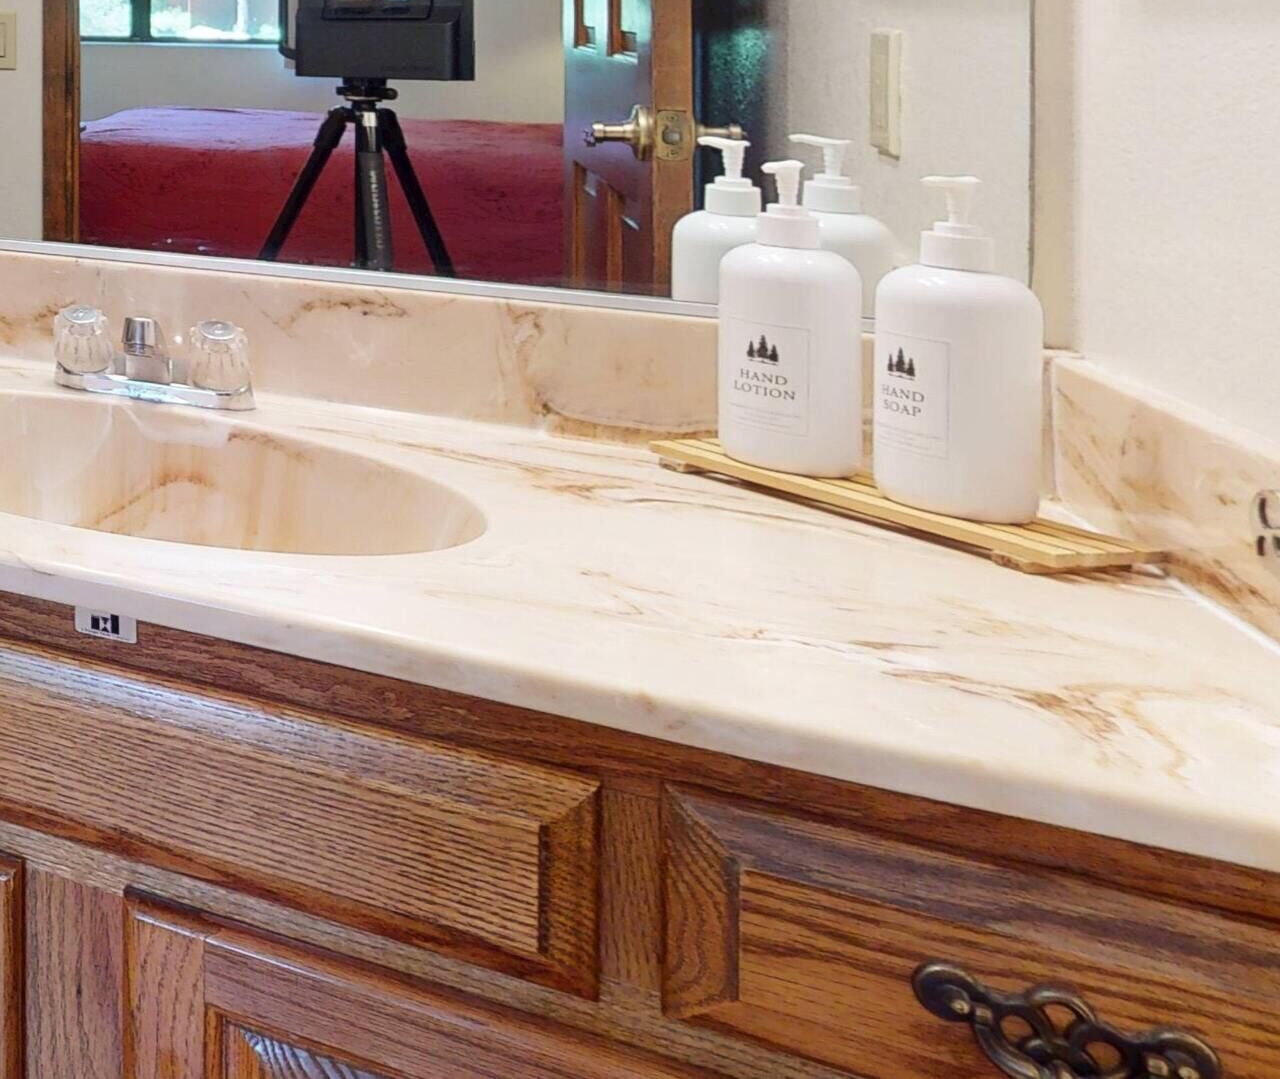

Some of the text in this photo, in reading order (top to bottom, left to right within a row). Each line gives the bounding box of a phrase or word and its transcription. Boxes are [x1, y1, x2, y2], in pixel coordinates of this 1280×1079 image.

[740, 367, 788, 386] HAND
[733, 379, 796, 401] LOTION
[881, 383, 925, 403] HAND
[882, 399, 922, 417] SOAP
